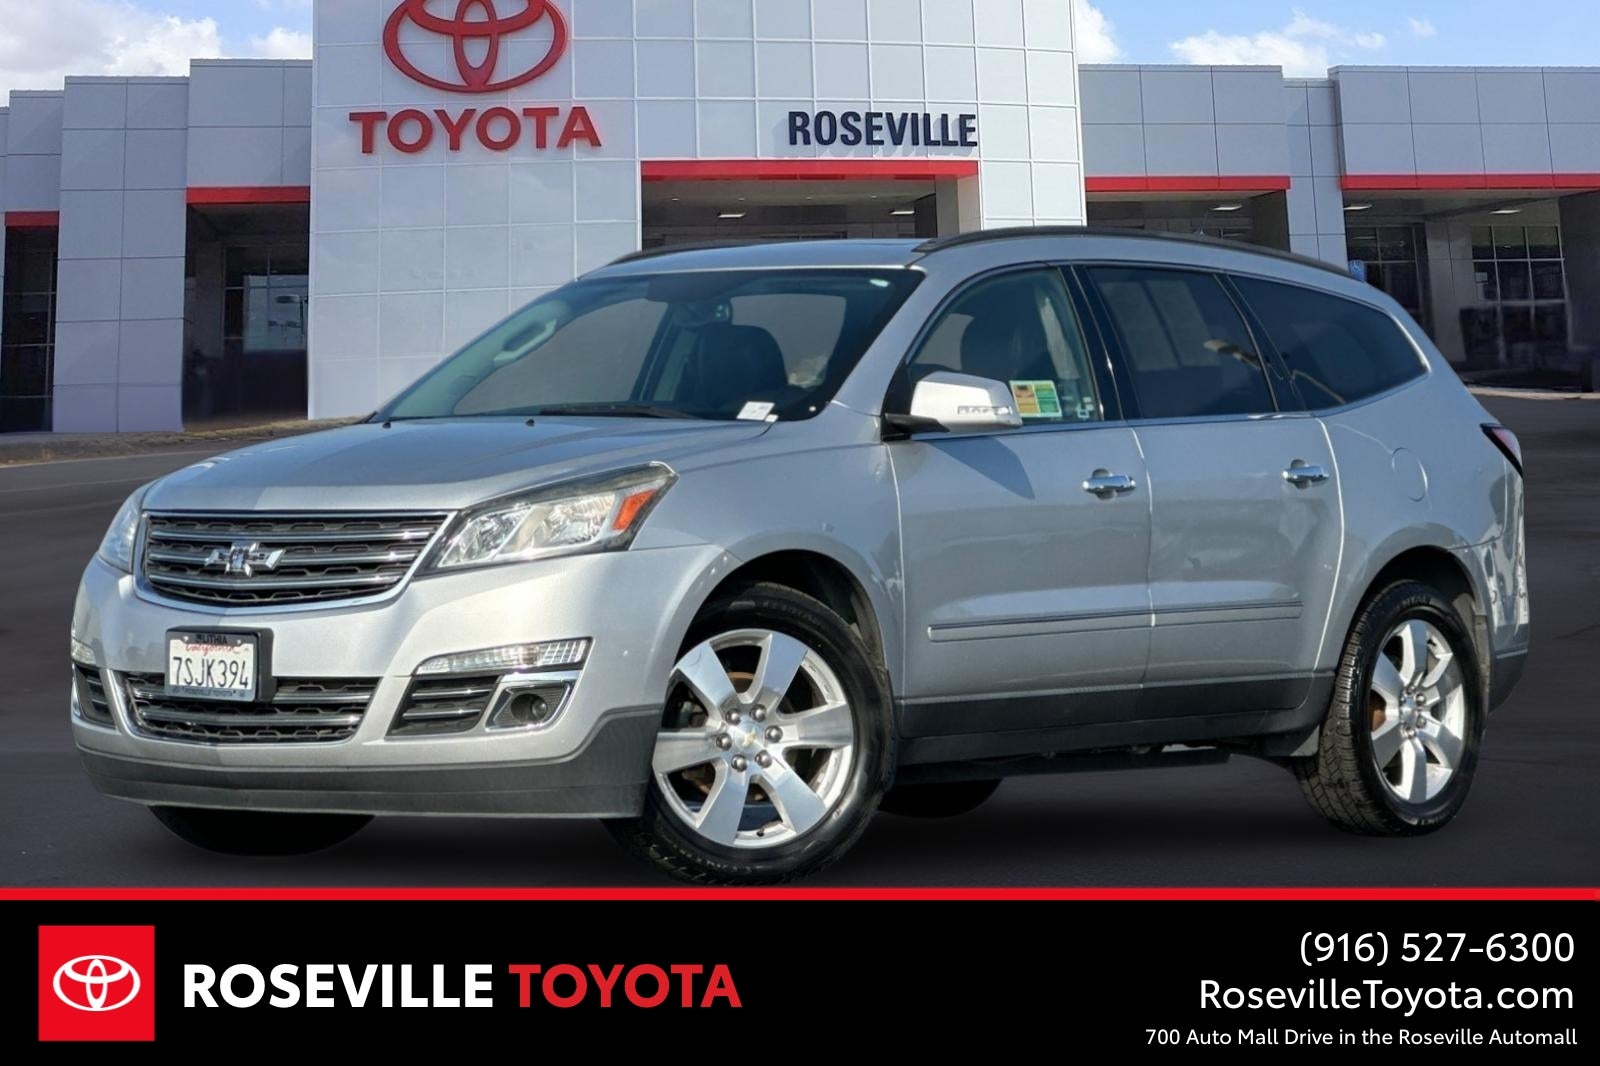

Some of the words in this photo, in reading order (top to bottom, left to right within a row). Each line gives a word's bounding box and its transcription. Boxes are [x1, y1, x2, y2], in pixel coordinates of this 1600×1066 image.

[349, 105, 602, 155] TOYOTA
[788, 110, 979, 148] ROSEVILLE
[173, 656, 248, 688] 7SJK394
